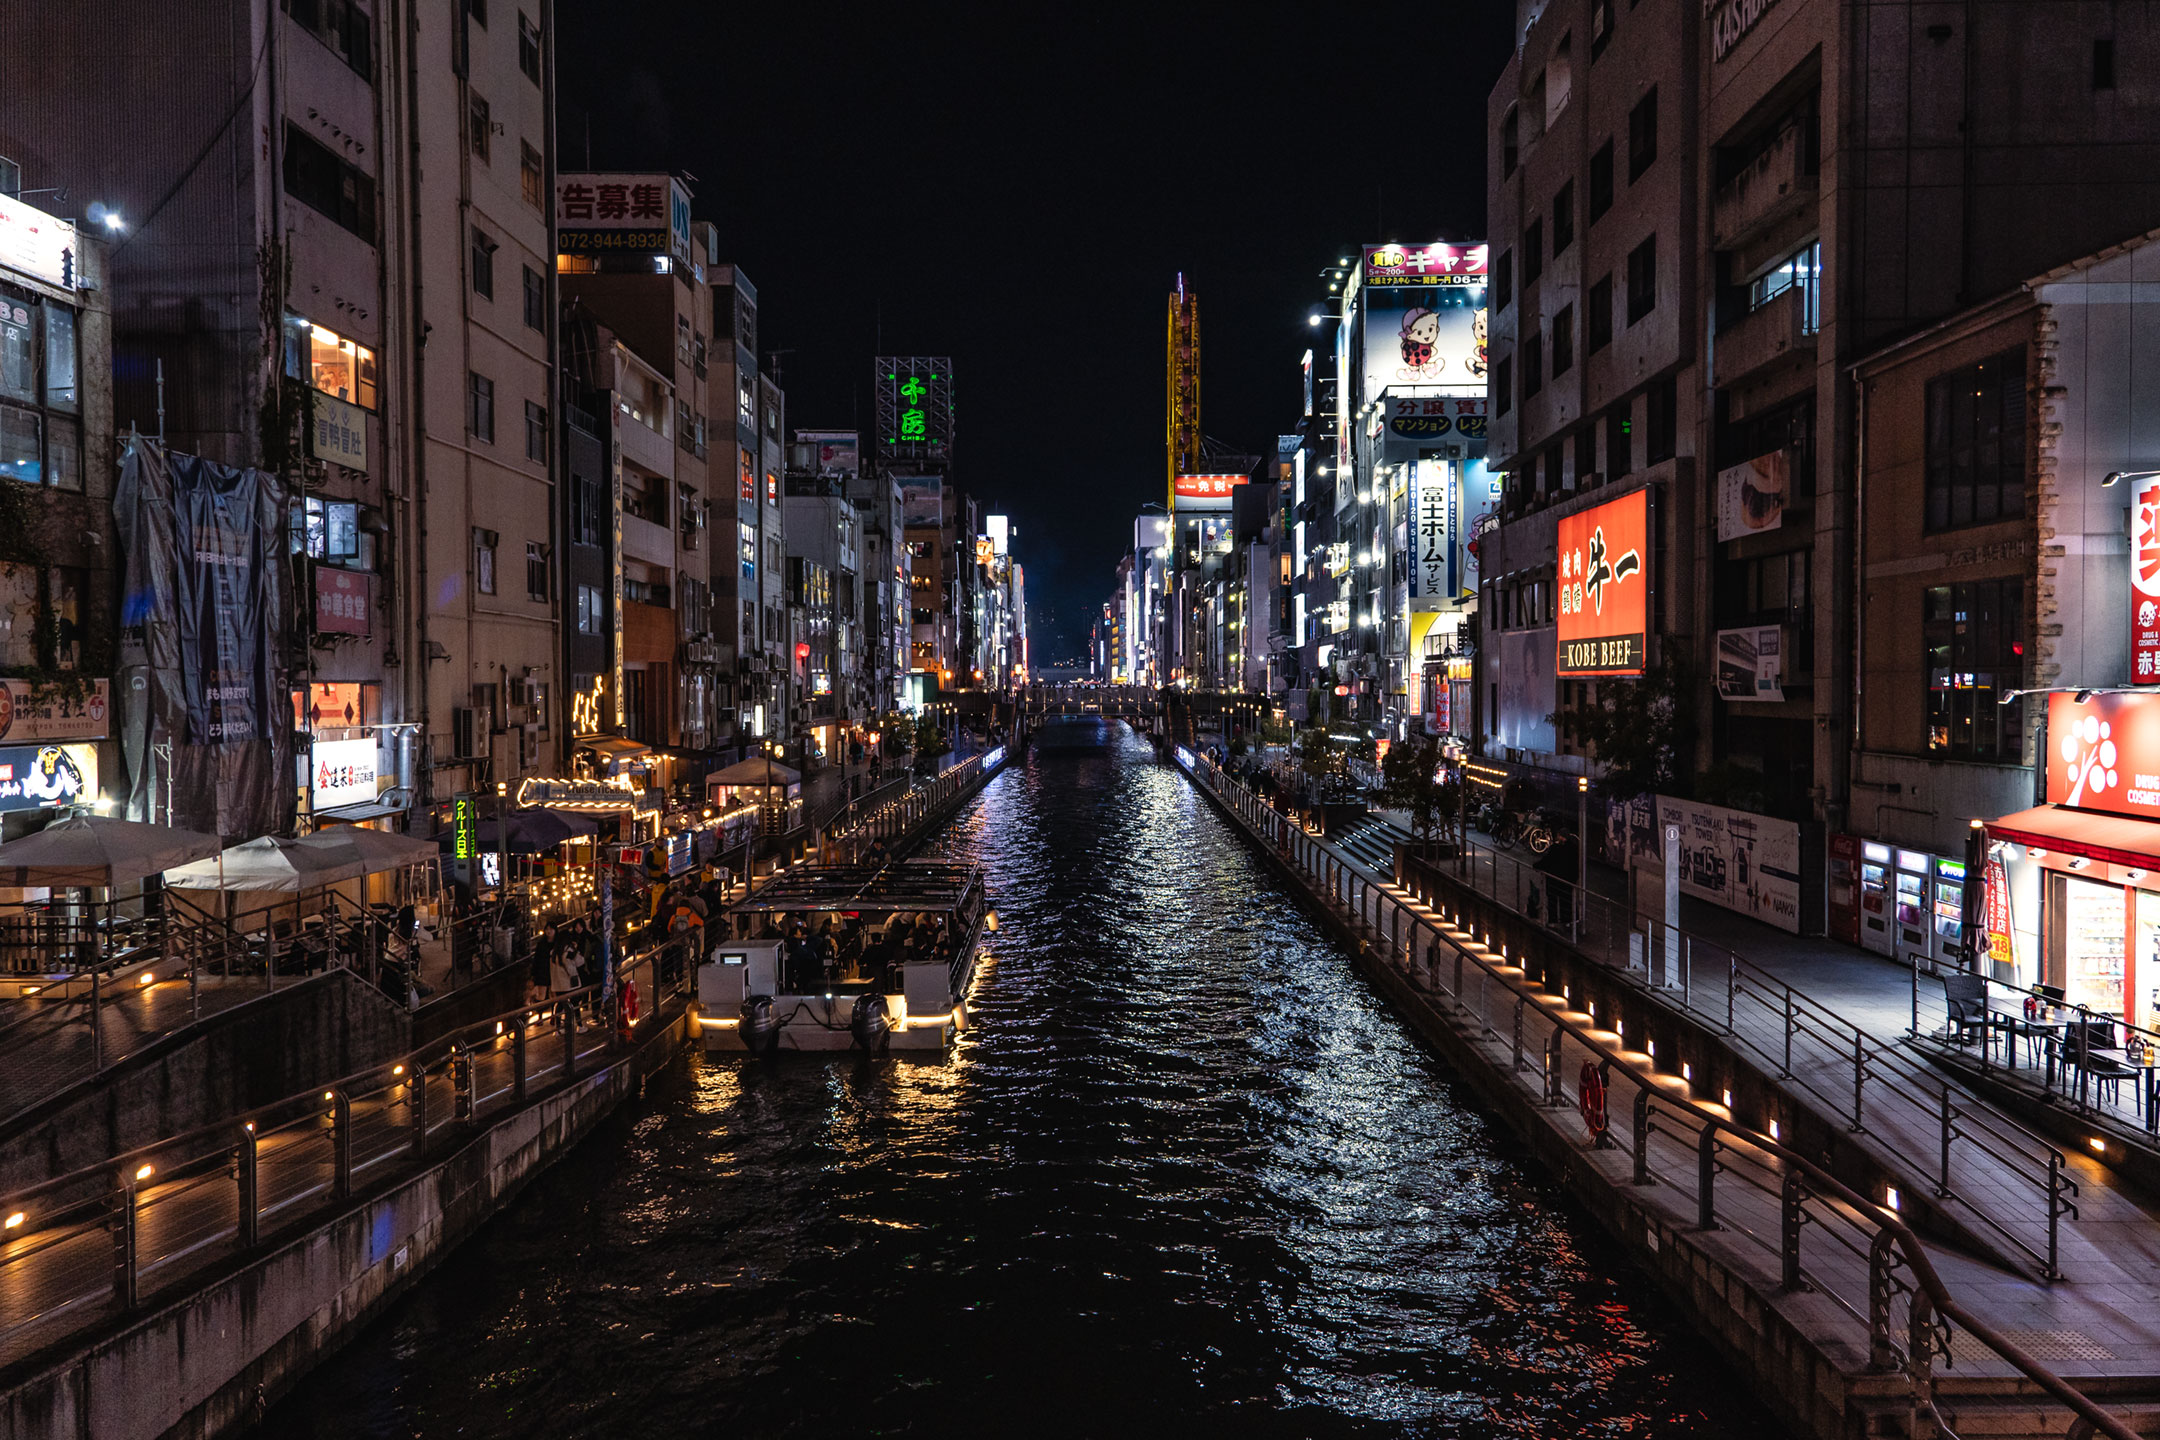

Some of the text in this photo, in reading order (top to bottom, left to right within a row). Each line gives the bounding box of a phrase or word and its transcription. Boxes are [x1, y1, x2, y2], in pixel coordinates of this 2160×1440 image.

[557, 184, 663, 220] 告募集
[559, 232, 666, 249] 072-944-8936
[900, 376, 927, 435] 千房
[1394, 418, 1450, 432] マンション
[1420, 486, 1445, 595] 富士ホームサービス
[1567, 639, 1631, 668] KOBE BEEF
[566, 785, 595, 795] Cruise
[456, 800, 468, 860] クルーズ日本
[1691, 813, 1724, 832] TSUTENKAKU
[1695, 827, 1713, 841] TOWER
[1773, 897, 1796, 918] NANKAI
[1993, 939, 2009, 954] 18
